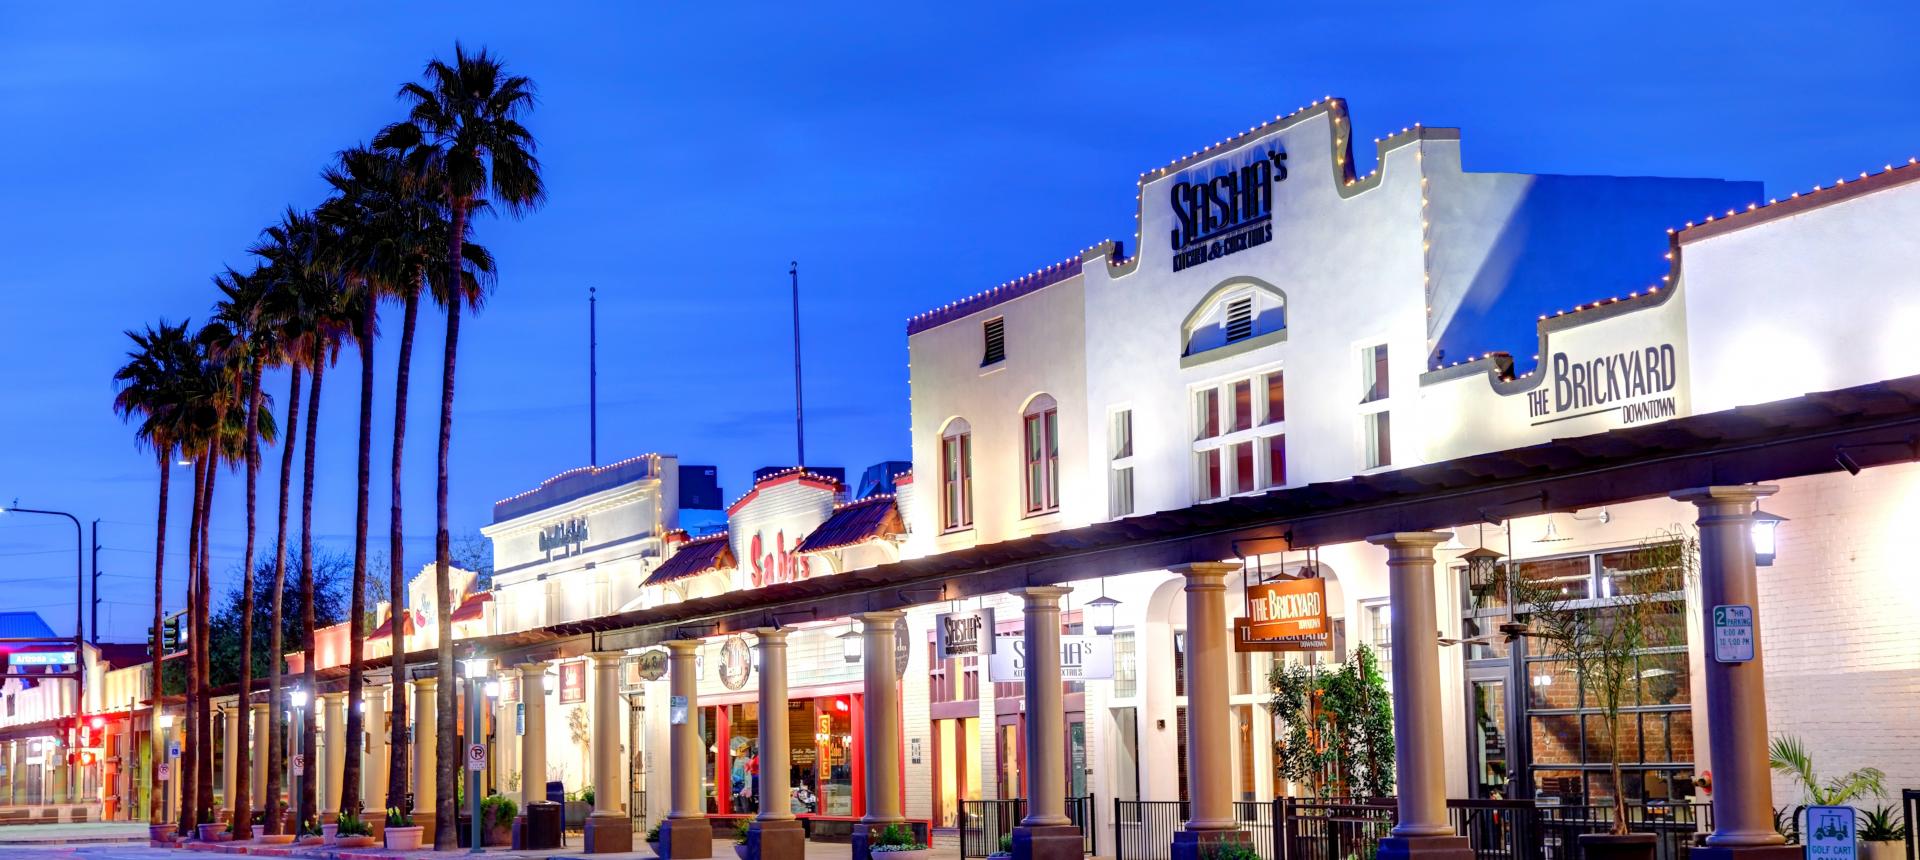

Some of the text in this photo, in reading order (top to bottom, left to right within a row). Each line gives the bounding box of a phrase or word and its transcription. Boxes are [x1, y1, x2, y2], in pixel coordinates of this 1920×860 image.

[1207, 241, 1224, 261] &
[1527, 388, 1549, 418] THE
[1623, 397, 1676, 424] DOWNTOWN
[1251, 598, 1269, 622] THE
[1716, 611, 1725, 625] 2
[1833, 846, 1851, 854] CART
